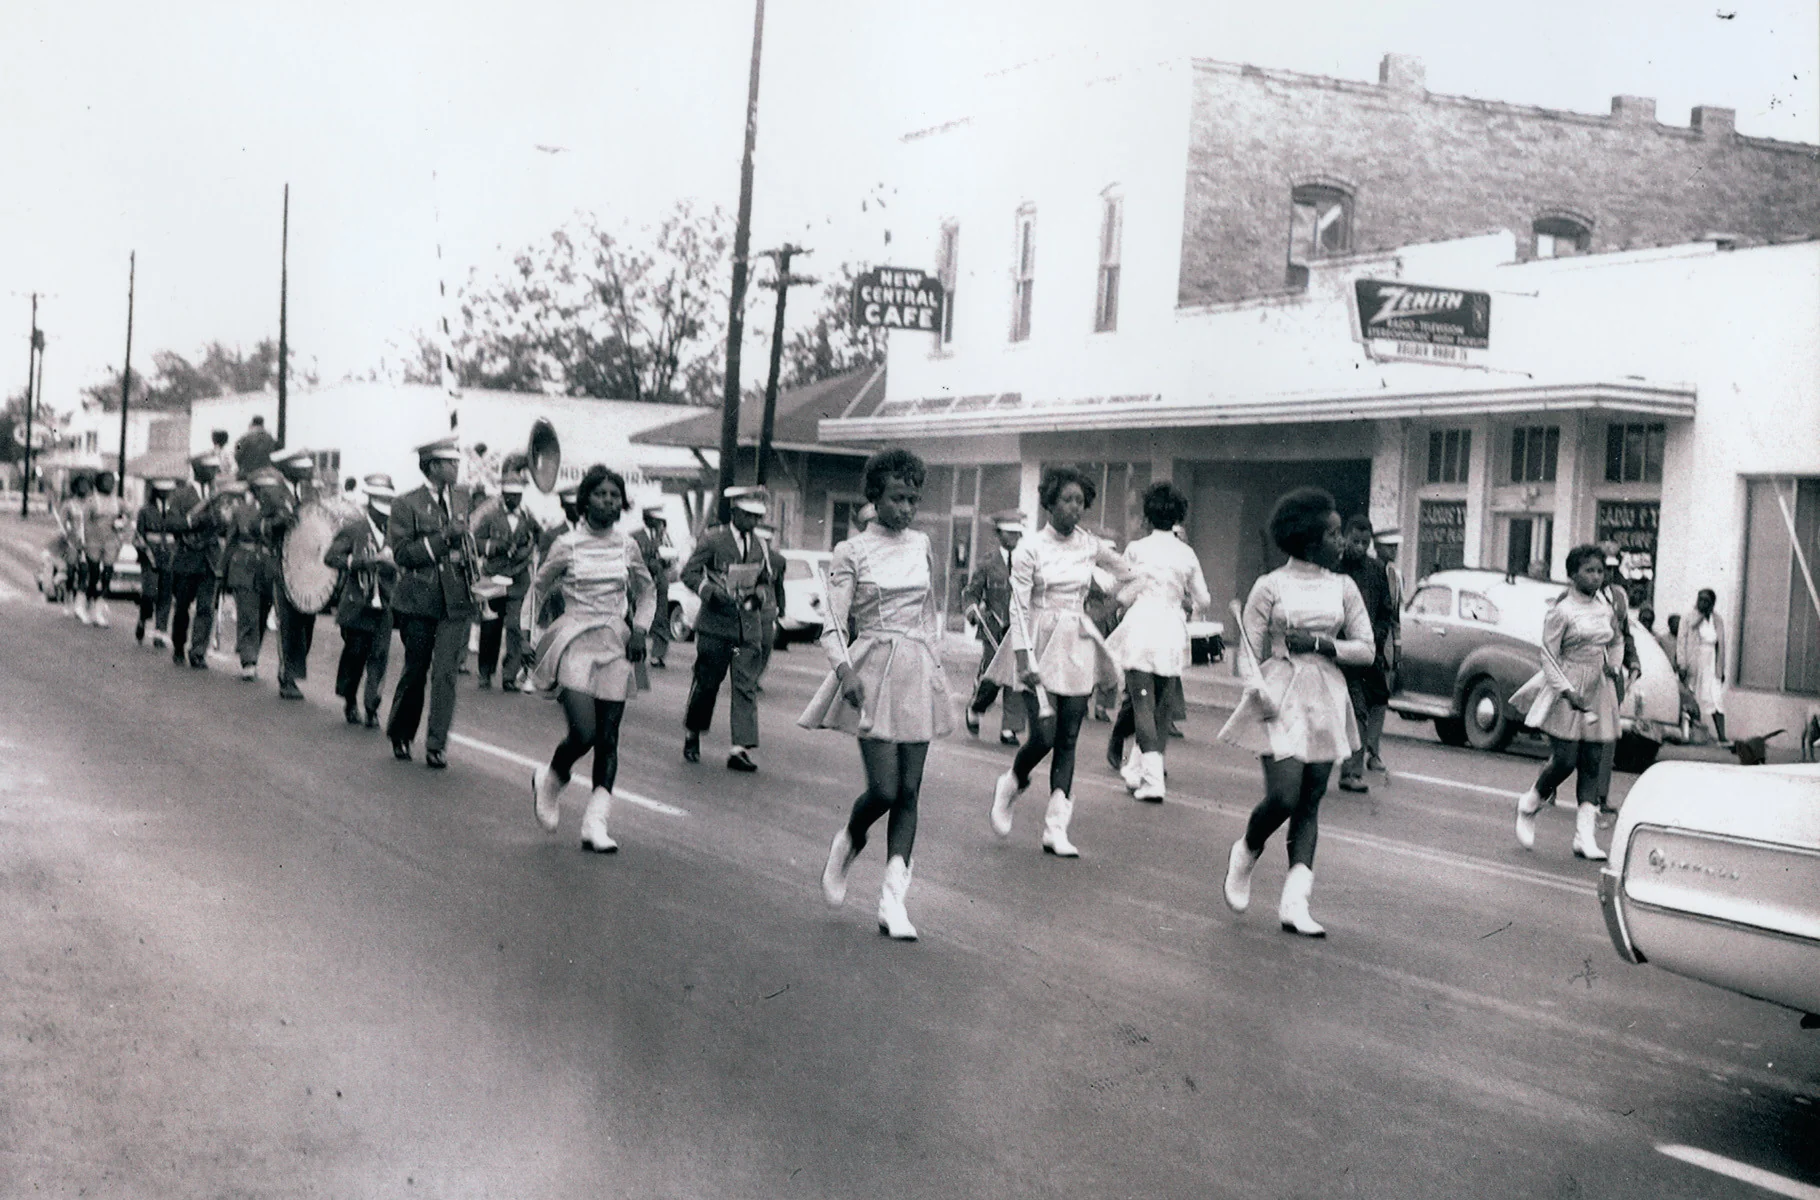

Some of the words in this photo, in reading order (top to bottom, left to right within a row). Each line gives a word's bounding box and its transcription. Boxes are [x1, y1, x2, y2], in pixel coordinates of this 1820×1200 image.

[880, 270, 922, 288] NEW
[861, 285, 938, 308] CENTRAL
[1369, 286, 1464, 324] ZENITH
[864, 303, 934, 329] CAFE
